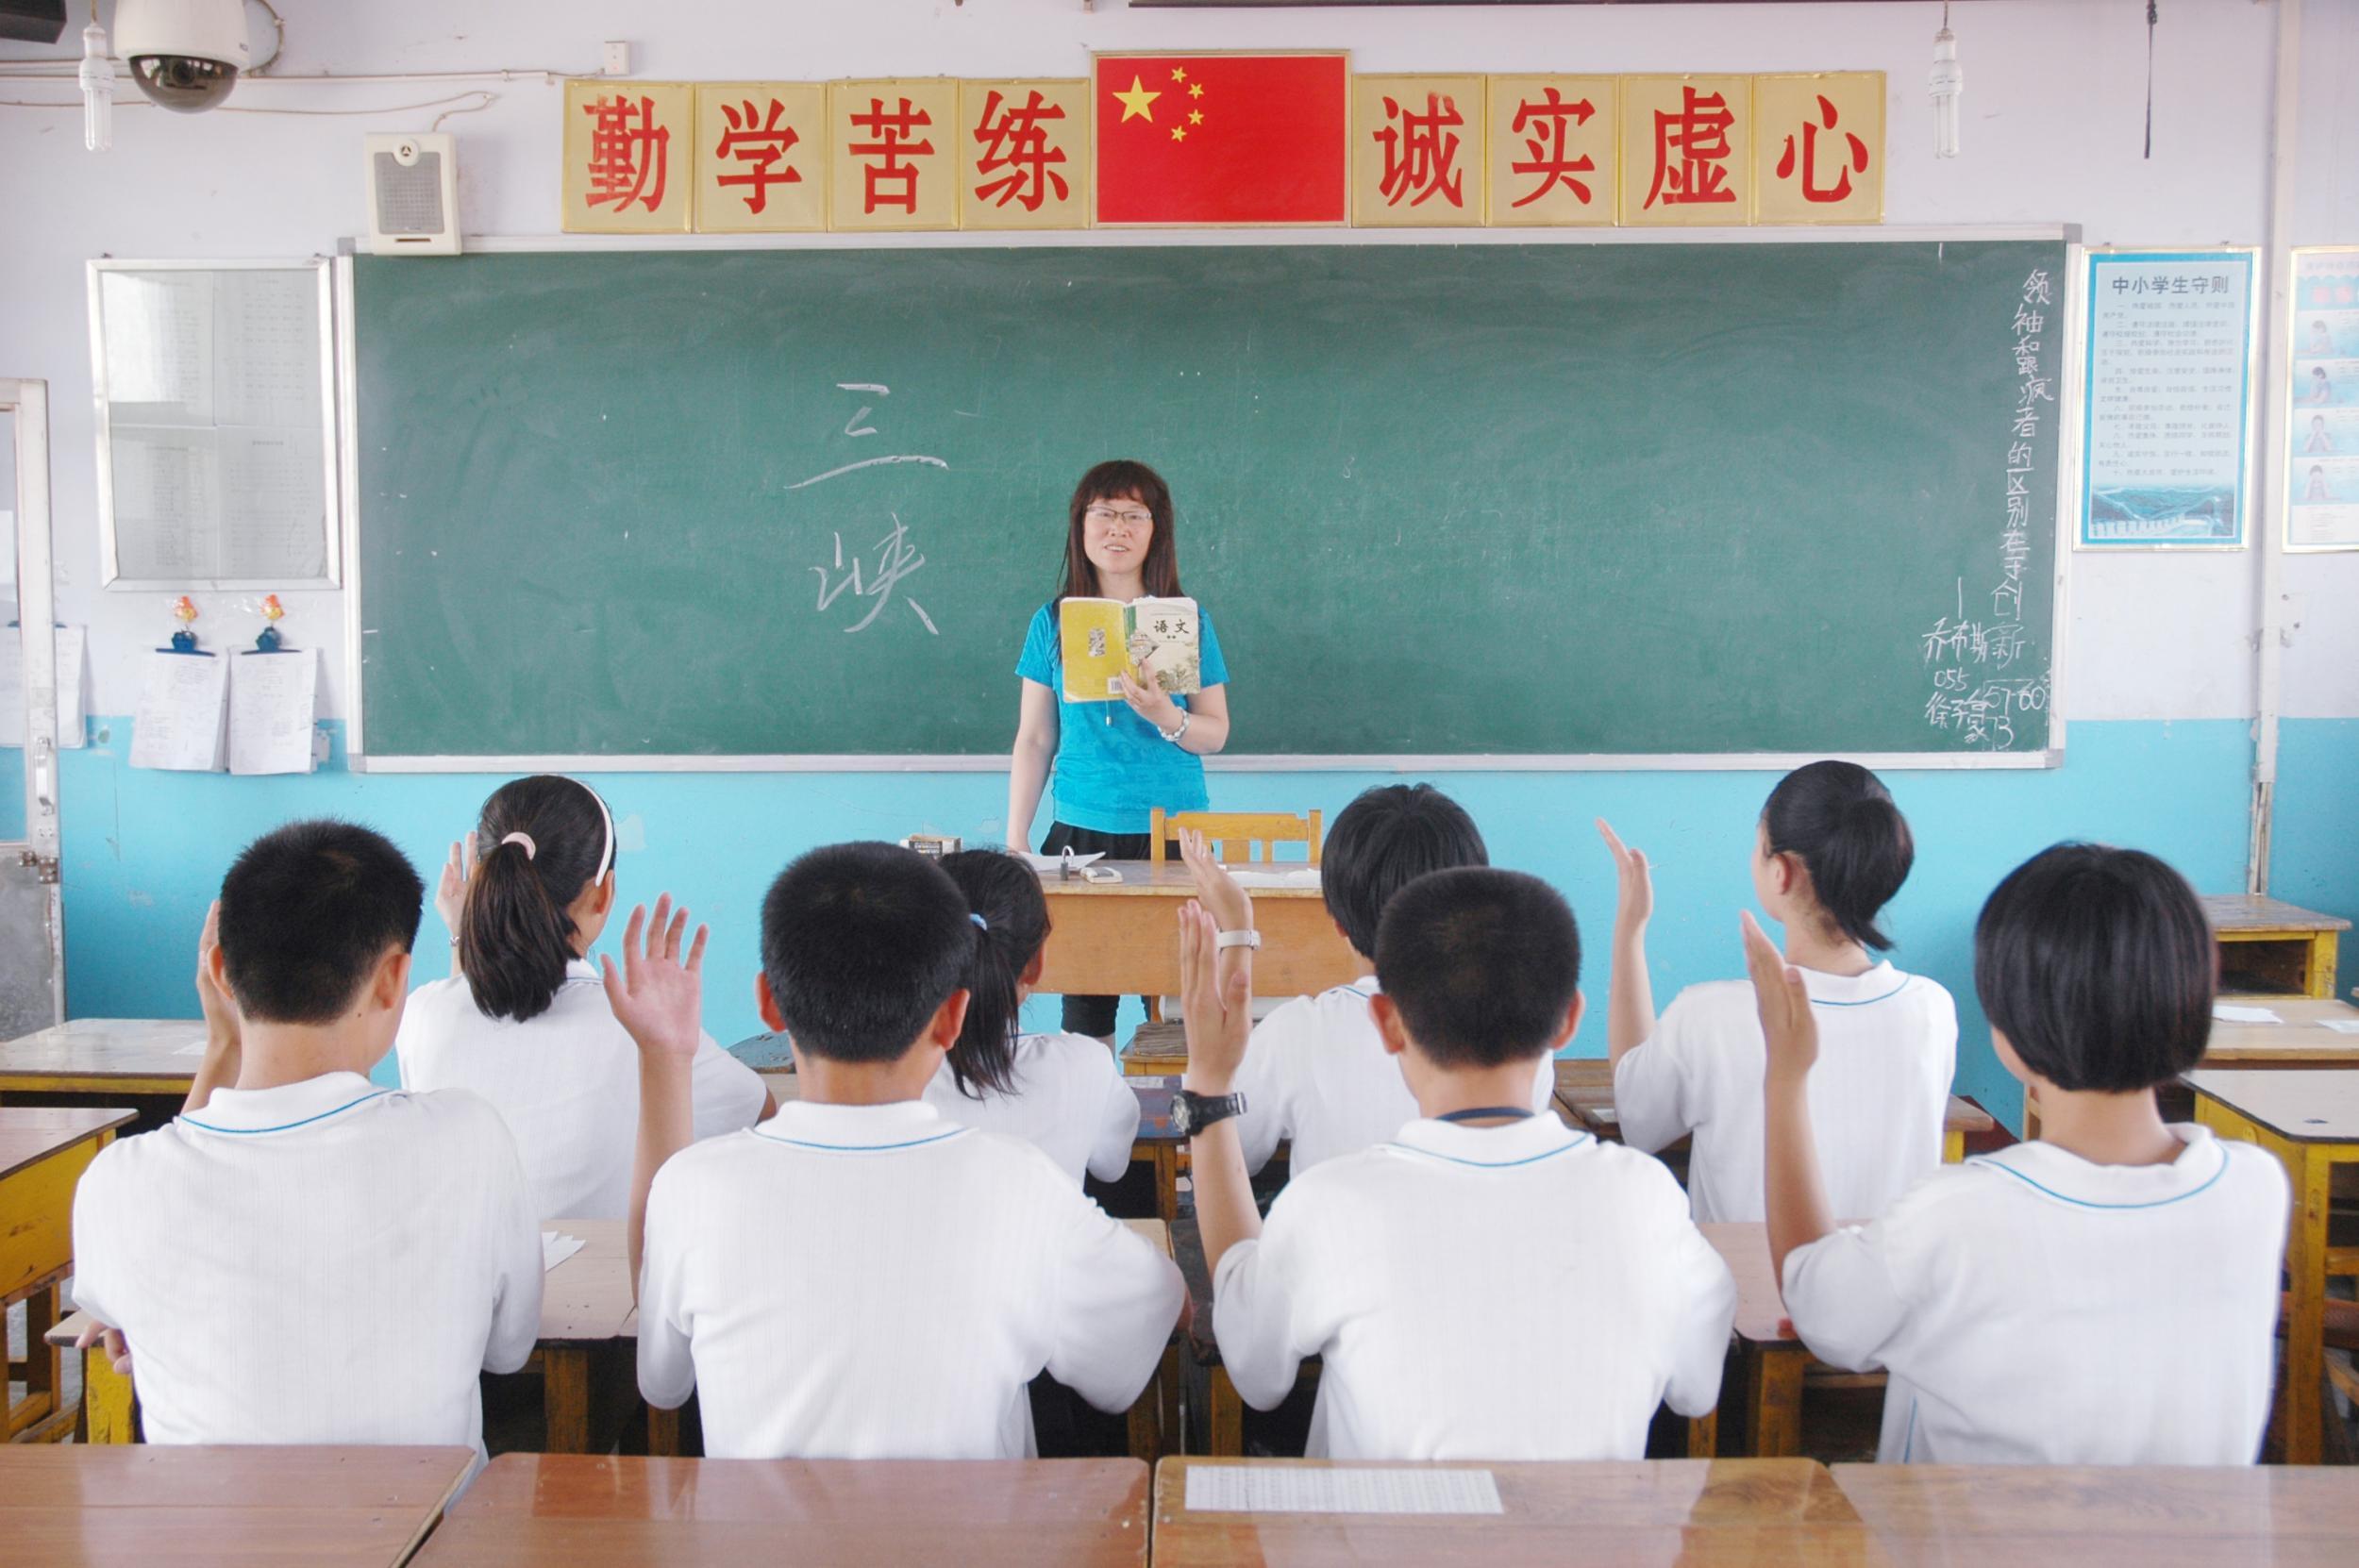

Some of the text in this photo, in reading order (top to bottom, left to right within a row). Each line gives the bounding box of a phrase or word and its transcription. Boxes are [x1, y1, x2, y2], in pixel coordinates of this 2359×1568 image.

[582, 90, 1070, 214] 勤学苦练
[1372, 85, 1869, 210] 诚实虚心
[2112, 275, 2230, 295] 中小学生守则
[1153, 619, 1190, 635] 语文
